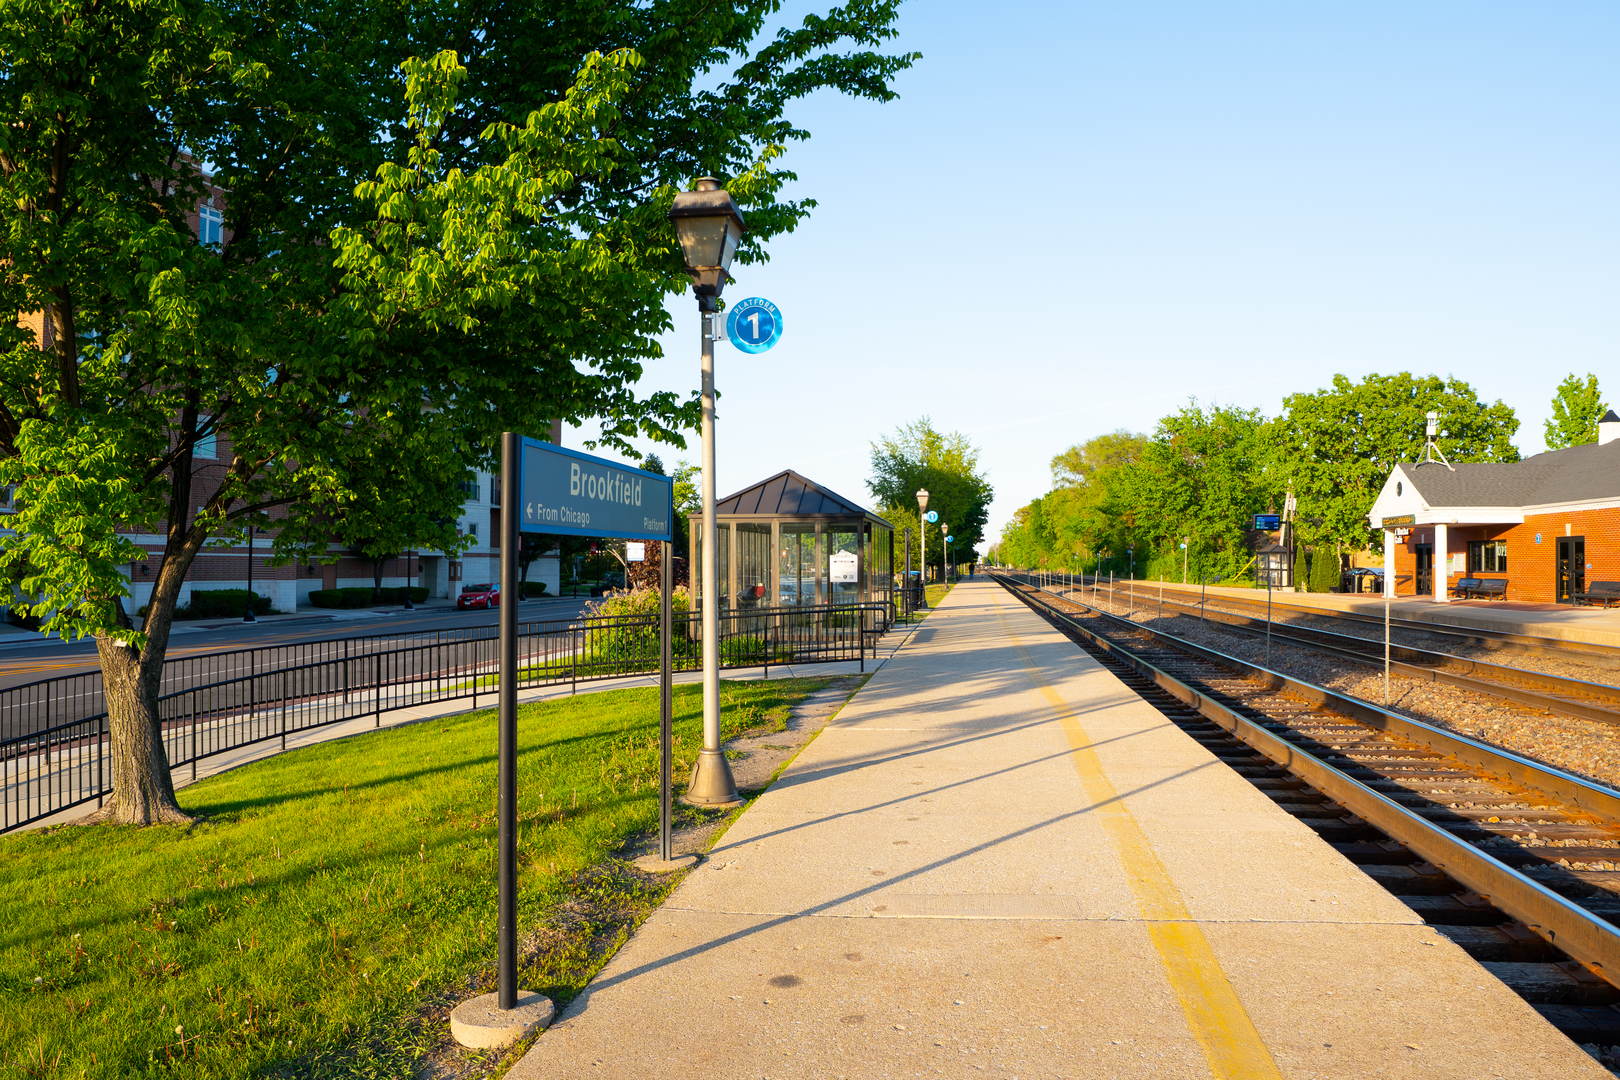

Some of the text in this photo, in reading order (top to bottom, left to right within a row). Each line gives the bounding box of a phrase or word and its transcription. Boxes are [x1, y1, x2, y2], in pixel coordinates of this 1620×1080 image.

[733, 298, 776, 314] PLATFORM
[747, 312, 759, 339] 1
[570, 462, 642, 507] Brookfield
[537, 503, 590, 528] From Chicago
[643, 516, 665, 531] Platform
